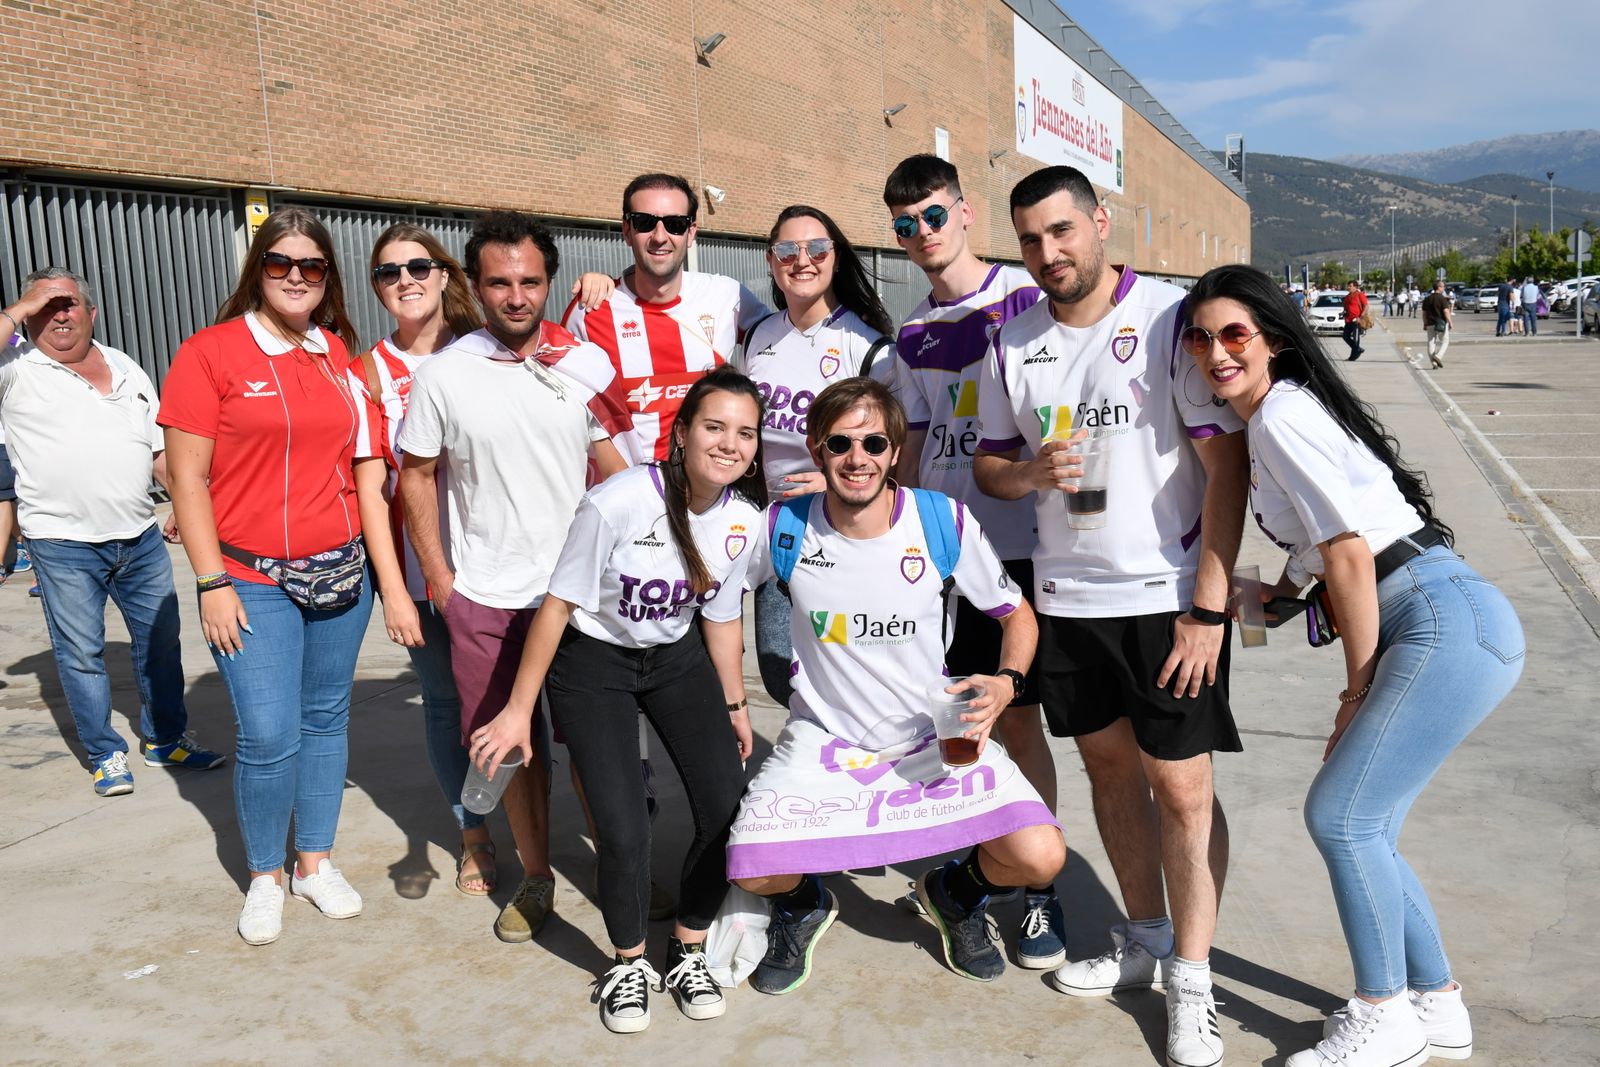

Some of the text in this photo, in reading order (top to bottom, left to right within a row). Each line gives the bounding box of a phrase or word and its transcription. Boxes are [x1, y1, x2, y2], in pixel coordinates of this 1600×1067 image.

[1032, 78, 1084, 149] Jiennenses
[1086, 114, 1098, 156] del
[1023, 356, 1059, 365] MERCURY
[755, 382, 815, 415] ODO
[1077, 398, 1129, 428] Jaén
[932, 421, 977, 460] Jaé
[800, 557, 836, 568] MERCURY
[853, 613, 916, 639] Jaén
[886, 809, 910, 821] club
[913, 807, 928, 818] de
[931, 801, 965, 816] fútbol
[782, 821, 798, 830] en
[801, 816, 831, 828] 1922
[1181, 988, 1204, 997] adidas
